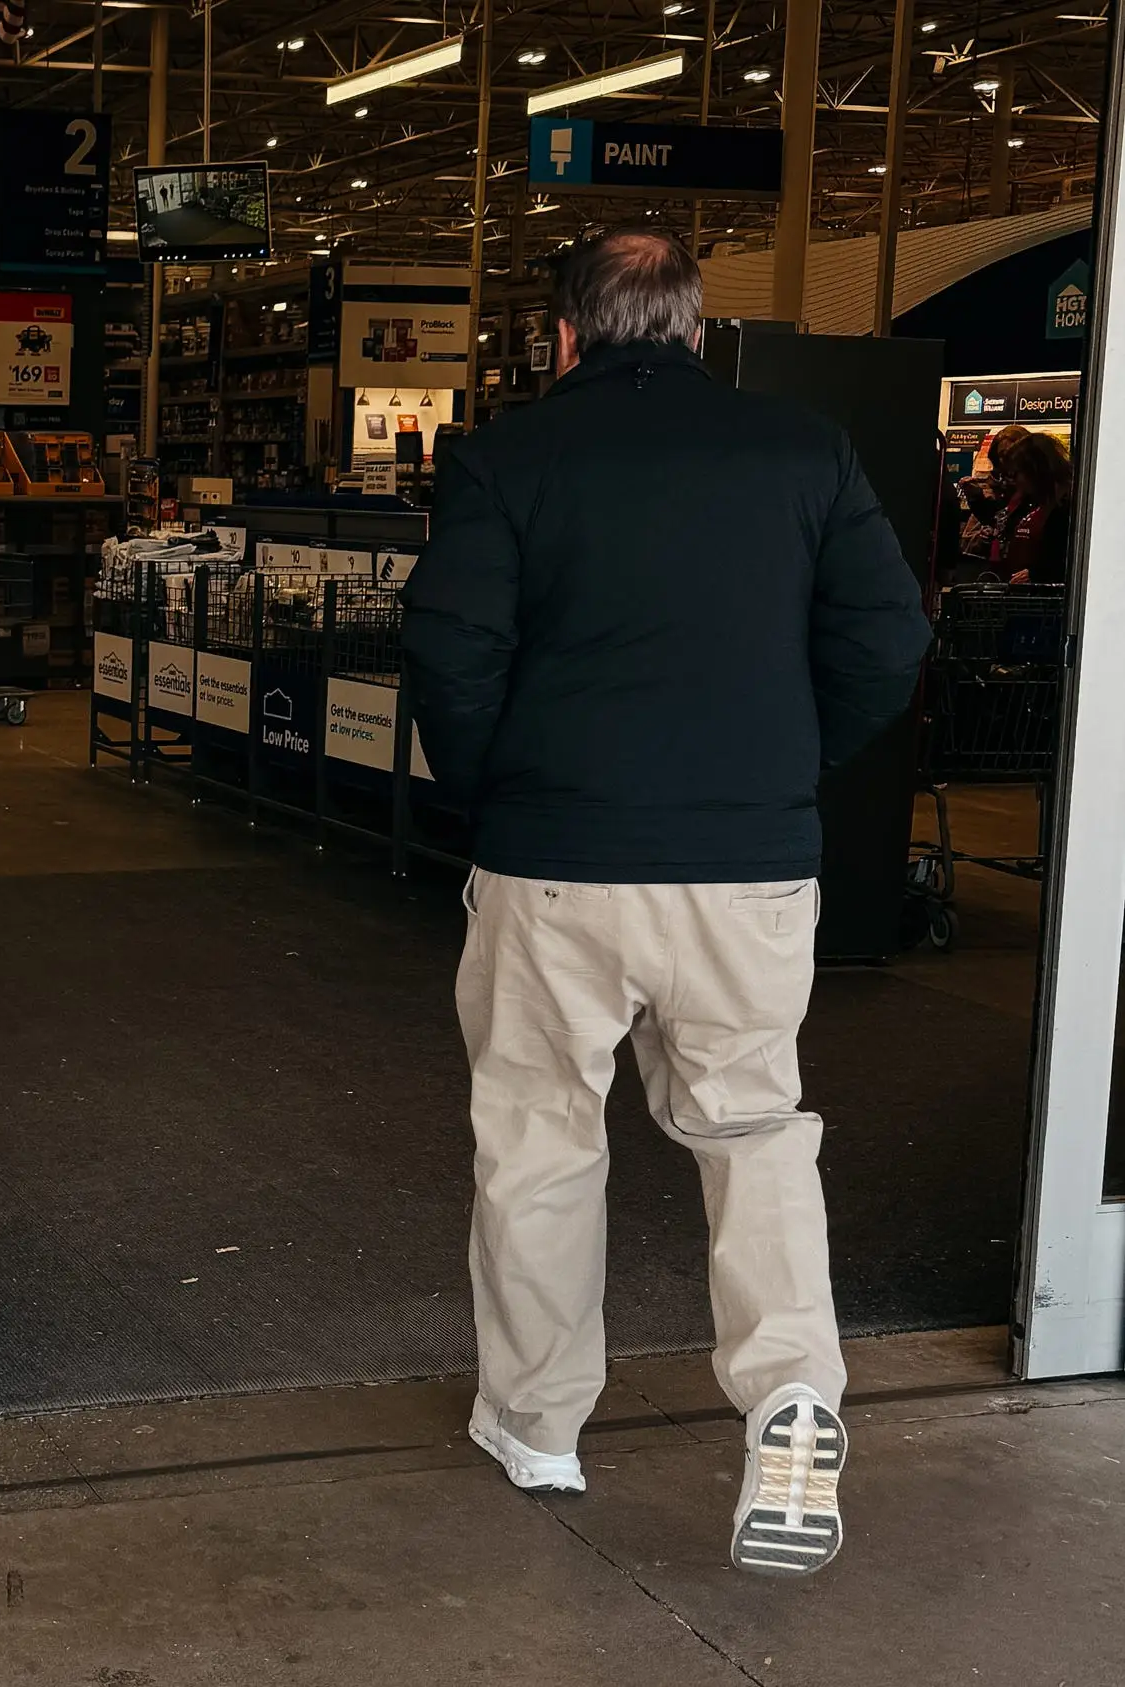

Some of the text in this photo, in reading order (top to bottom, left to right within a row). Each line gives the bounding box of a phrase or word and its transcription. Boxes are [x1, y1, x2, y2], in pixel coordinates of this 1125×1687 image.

[63, 118, 98, 176] 2
[603, 142, 673, 167] PAINT
[325, 265, 336, 301] 3
[420, 319, 456, 329] ProBlock
[1019, 398, 1053, 414] Design
[1054, 396, 1073, 412] Exp
[98, 662, 128, 681] essentials
[154, 674, 191, 694] essentials
[199, 674, 248, 696] Get the essentials
[199, 691, 206, 700] at
[206, 692, 217, 702] low
[330, 704, 393, 728] Get the essentials
[262, 724, 310, 753] Low Price
[330, 722, 375, 741] at low prices.
